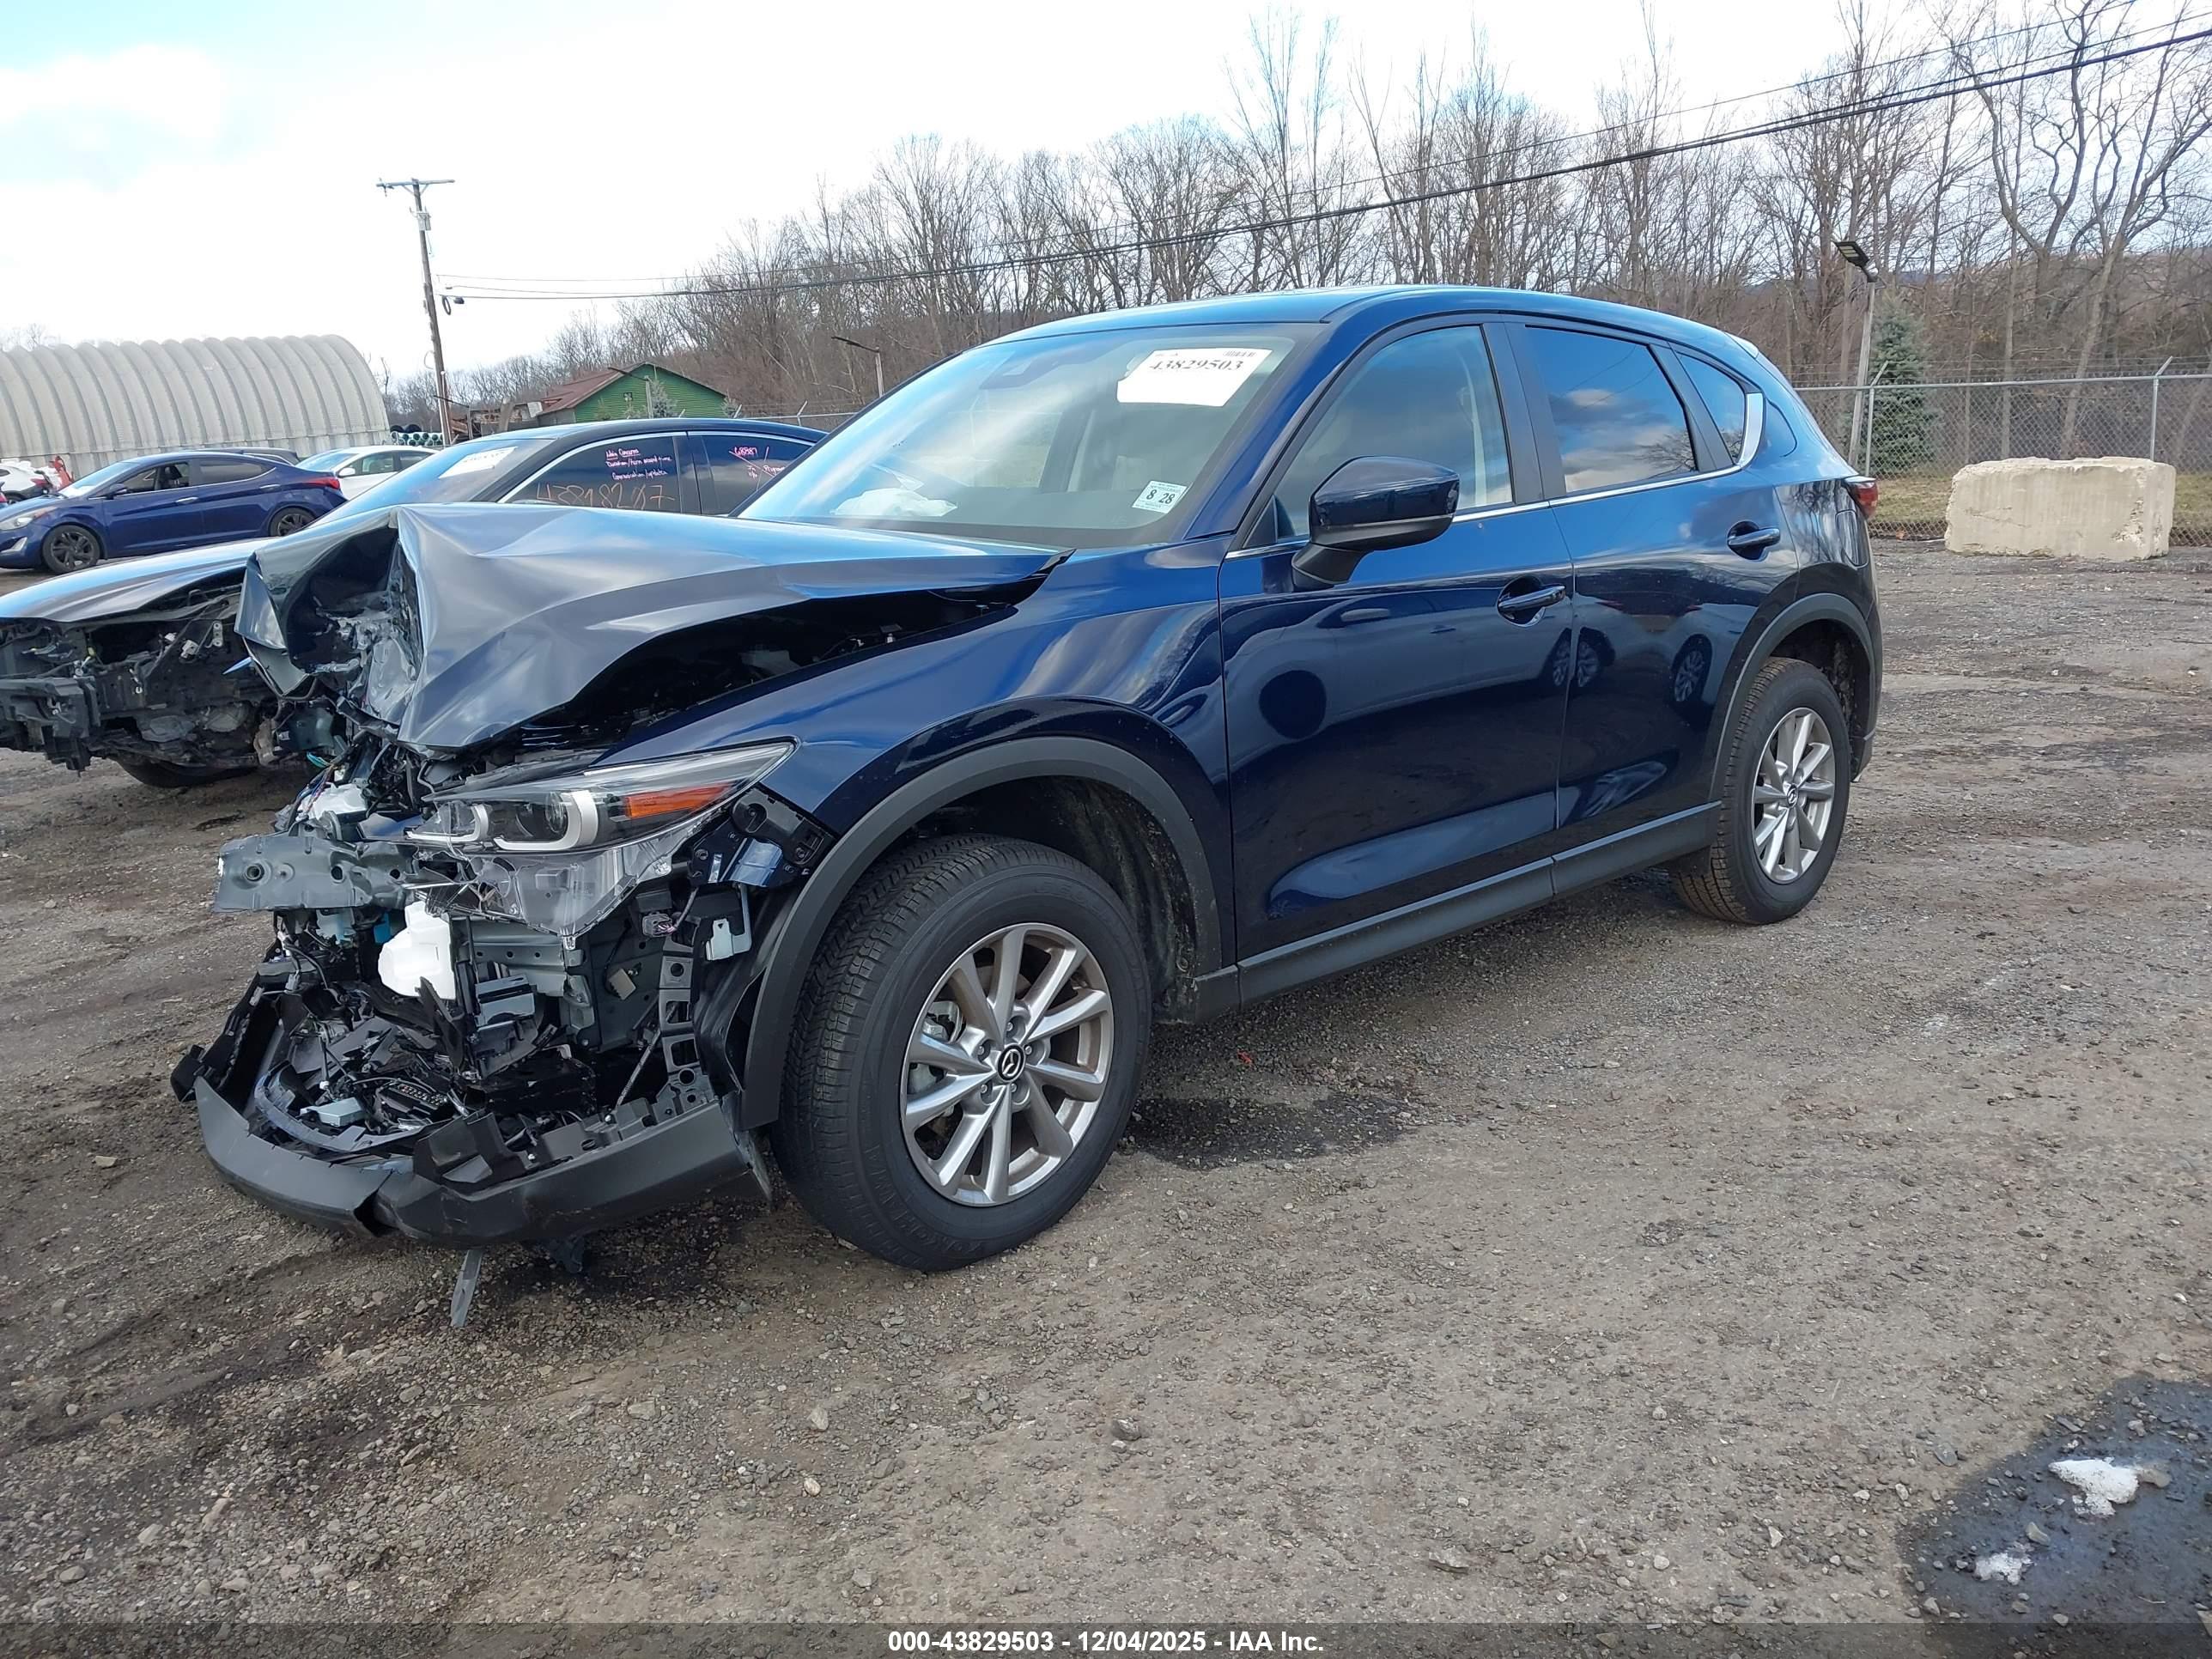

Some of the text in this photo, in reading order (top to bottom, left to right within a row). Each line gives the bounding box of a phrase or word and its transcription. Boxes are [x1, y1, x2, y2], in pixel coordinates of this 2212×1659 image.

[1149, 359, 1244, 371] 43829503
[1146, 489, 1176, 504] 8 28
